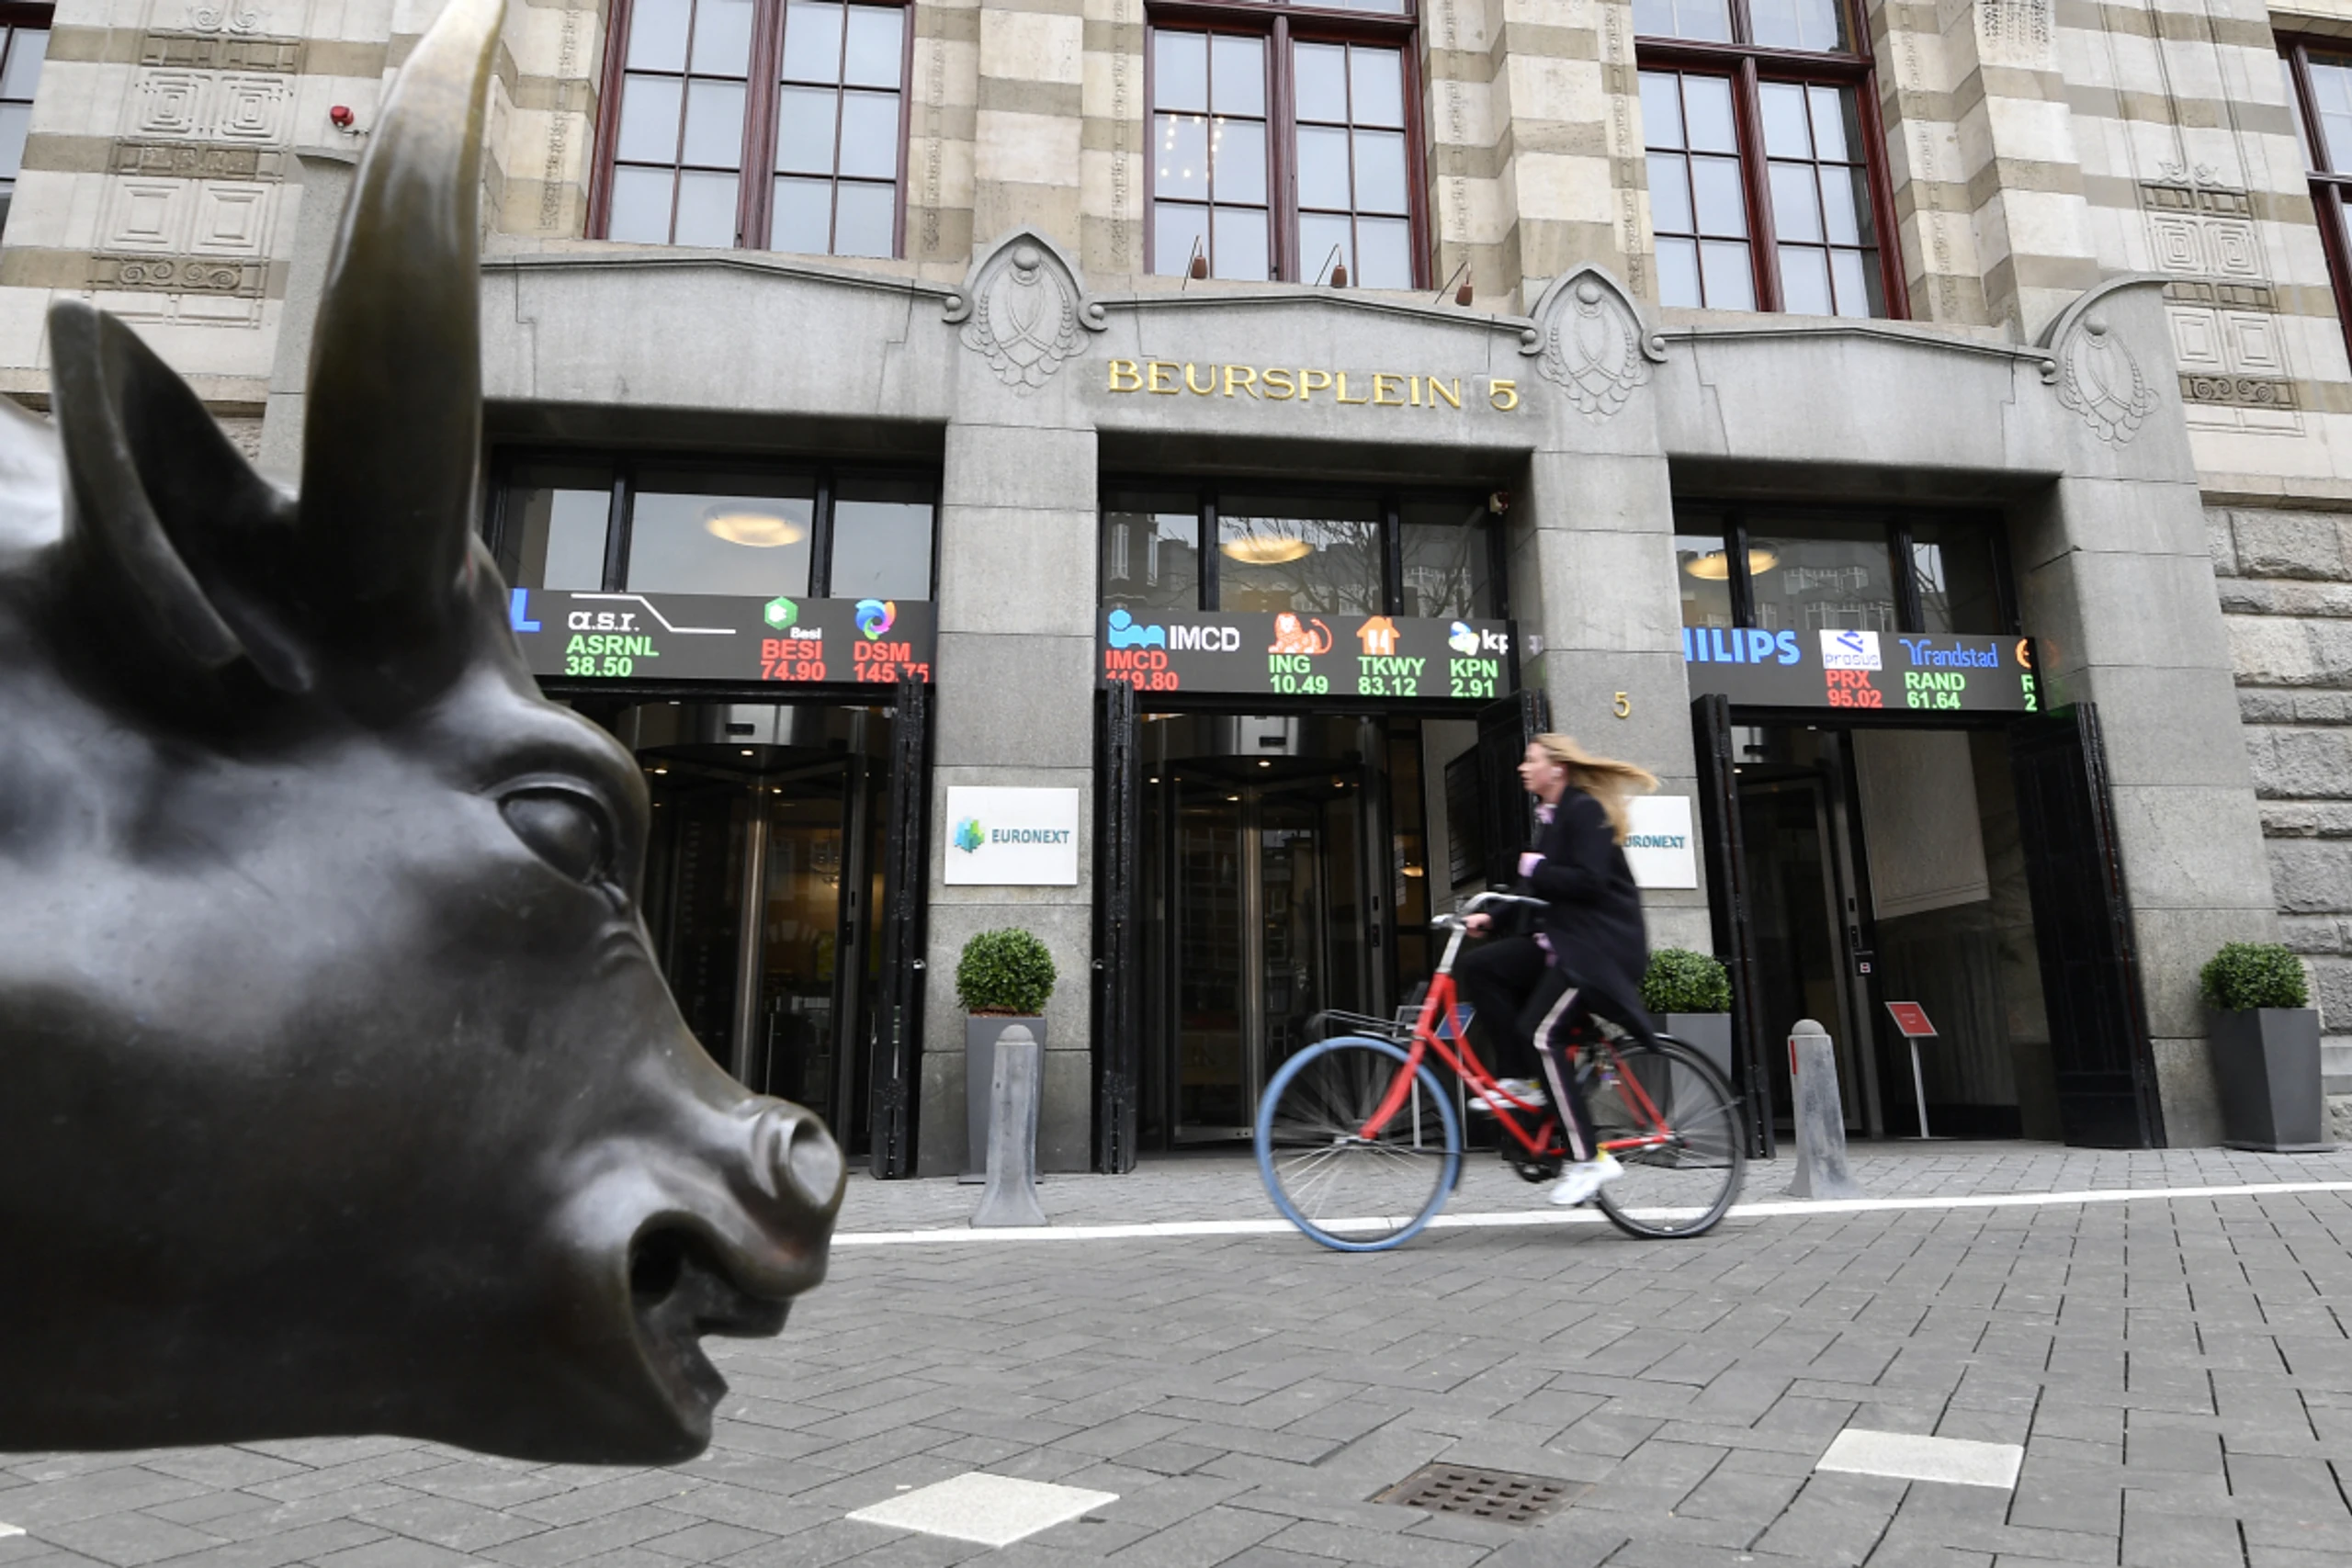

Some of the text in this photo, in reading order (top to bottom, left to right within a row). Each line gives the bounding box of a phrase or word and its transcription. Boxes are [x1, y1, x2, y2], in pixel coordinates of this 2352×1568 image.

[1107, 359, 1519, 412] BEURSPLEIN 5
[510, 587, 541, 632] L
[566, 634, 660, 657] ASRNL
[1170, 625, 1240, 651] IMCD
[762, 639, 823, 660] BESI
[854, 640, 911, 662] DSM
[1105, 649, 1169, 671] IMCD
[1924, 641, 1999, 668] randstad
[565, 656, 633, 677] 38.50
[761, 660, 827, 682] 74.90
[1268, 654, 1311, 673] ING
[1357, 656, 1426, 677] TKWY
[1450, 658, 1498, 679] KPN
[1270, 674, 1329, 694] 10.49
[1358, 676, 1418, 697] 83.12
[1450, 677, 1495, 698] 2.91
[1825, 670, 1871, 689] PRX
[1904, 671, 1966, 692] RAND
[1613, 691, 1631, 719] 5
[1826, 688, 1883, 709] 95.02
[1906, 690, 1962, 710] 61.64
[991, 829, 1070, 844] EURONEXT
[1624, 834, 1686, 850] URONEXT
